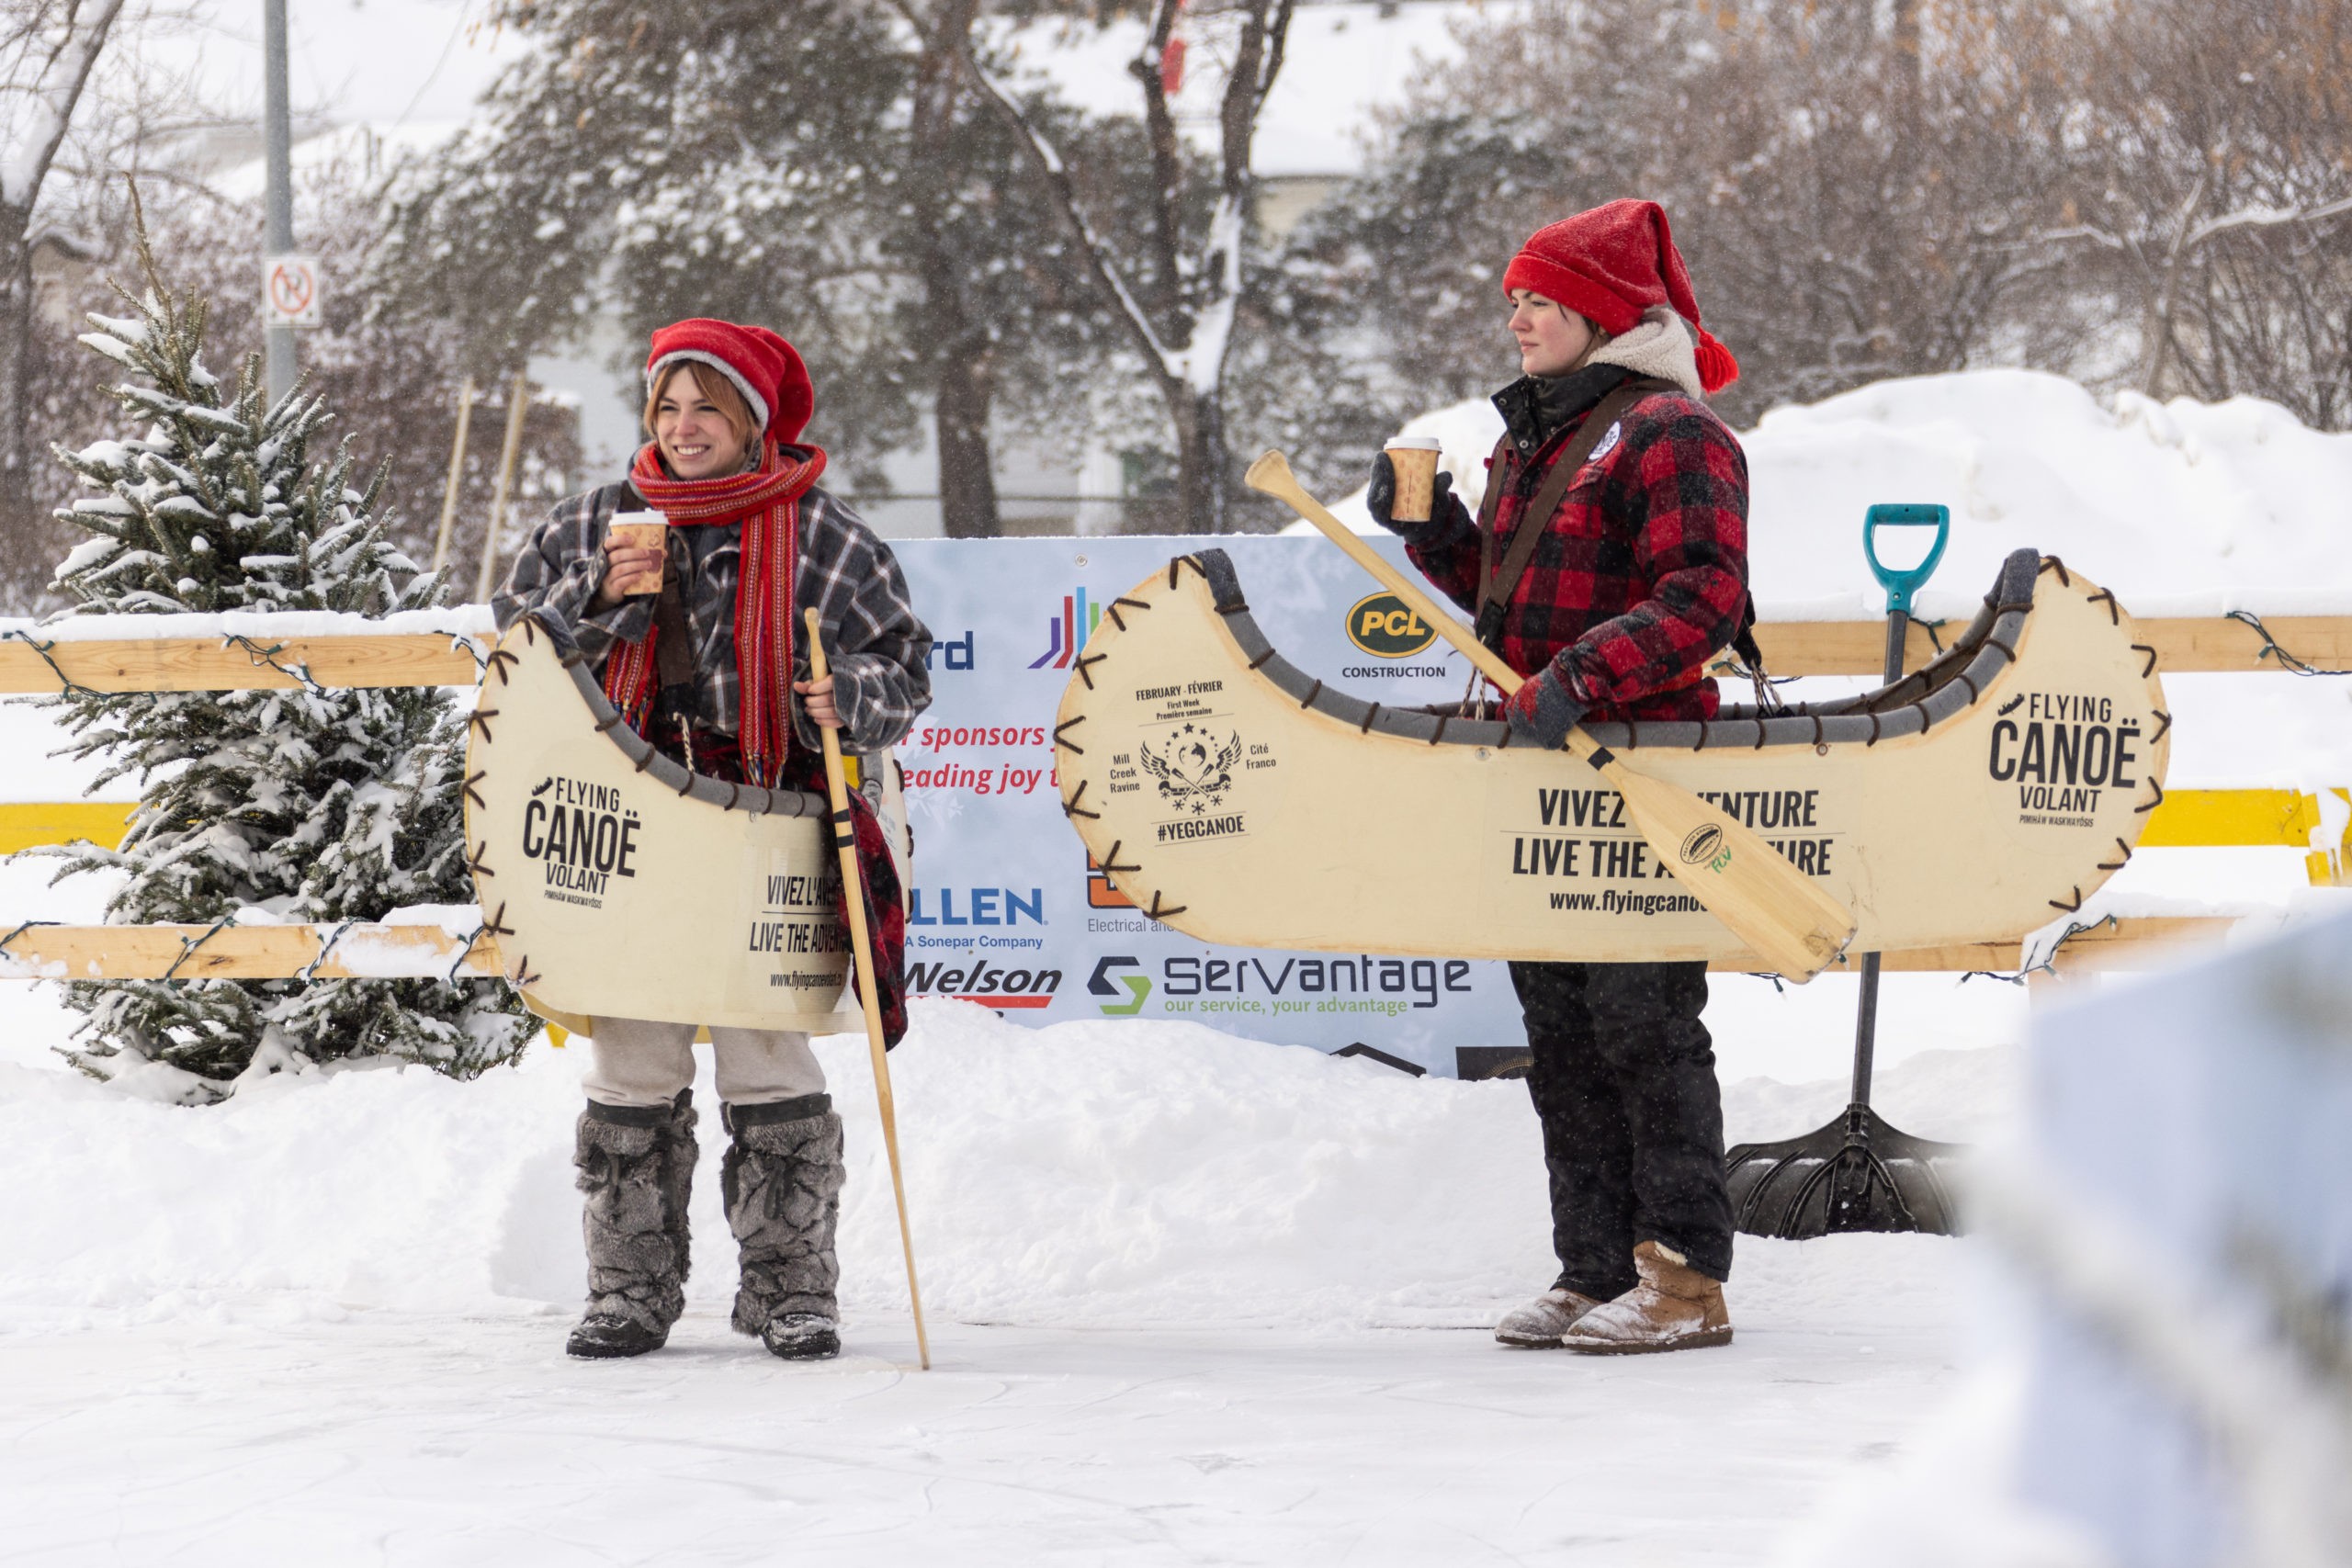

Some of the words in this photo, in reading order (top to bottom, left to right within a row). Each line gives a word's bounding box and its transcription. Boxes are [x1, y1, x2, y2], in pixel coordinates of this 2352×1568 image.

[1361, 610, 1426, 637] PCL
[925, 631, 974, 671] rd
[1342, 667, 1446, 678] CONSTRUCTION
[1136, 686, 1182, 701] FEBRUARY
[1188, 681, 1223, 695] FÉVRIER
[1167, 700, 1182, 710] First
[1182, 698, 1200, 707] Week
[1156, 710, 1185, 720] Première
[1185, 707, 1213, 717] semaine
[2030, 693, 2111, 723] FLYING
[921, 727, 1045, 752] sponsors
[1250, 742, 1270, 756] Cité
[1989, 718, 2141, 788] CANOË
[1113, 753, 1130, 765] Mill
[1246, 758, 1276, 771] Franco
[904, 763, 993, 795] eading
[996, 763, 1042, 795] joy
[1110, 767, 1137, 780] Creek
[556, 776, 620, 813] FLYING
[1110, 782, 1140, 794] Ravine
[2020, 785, 2102, 812] VOLANT
[1538, 788, 1626, 829] VIVEZ
[523, 799, 641, 878] CANOË
[1158, 815, 1245, 841] #YEGCANOE
[1513, 838, 1581, 877] LIVE
[1589, 840, 1649, 878] THE
[546, 862, 610, 896] VOLANT
[767, 875, 806, 906] VIVEZ
[910, 888, 1043, 926] LLEN
[749, 922, 784, 952] LIVE
[787, 923, 810, 953] THE
[1088, 919, 1147, 932] Electrical
[905, 936, 914, 947] A
[918, 935, 975, 950] Sonepar
[979, 935, 1043, 950] Company
[905, 960, 1063, 993] Nelson
[1164, 999, 1194, 1012] our
[1199, 996, 1266, 1015] service,
[1272, 999, 1310, 1017] your
[1316, 996, 1408, 1017] advantage
